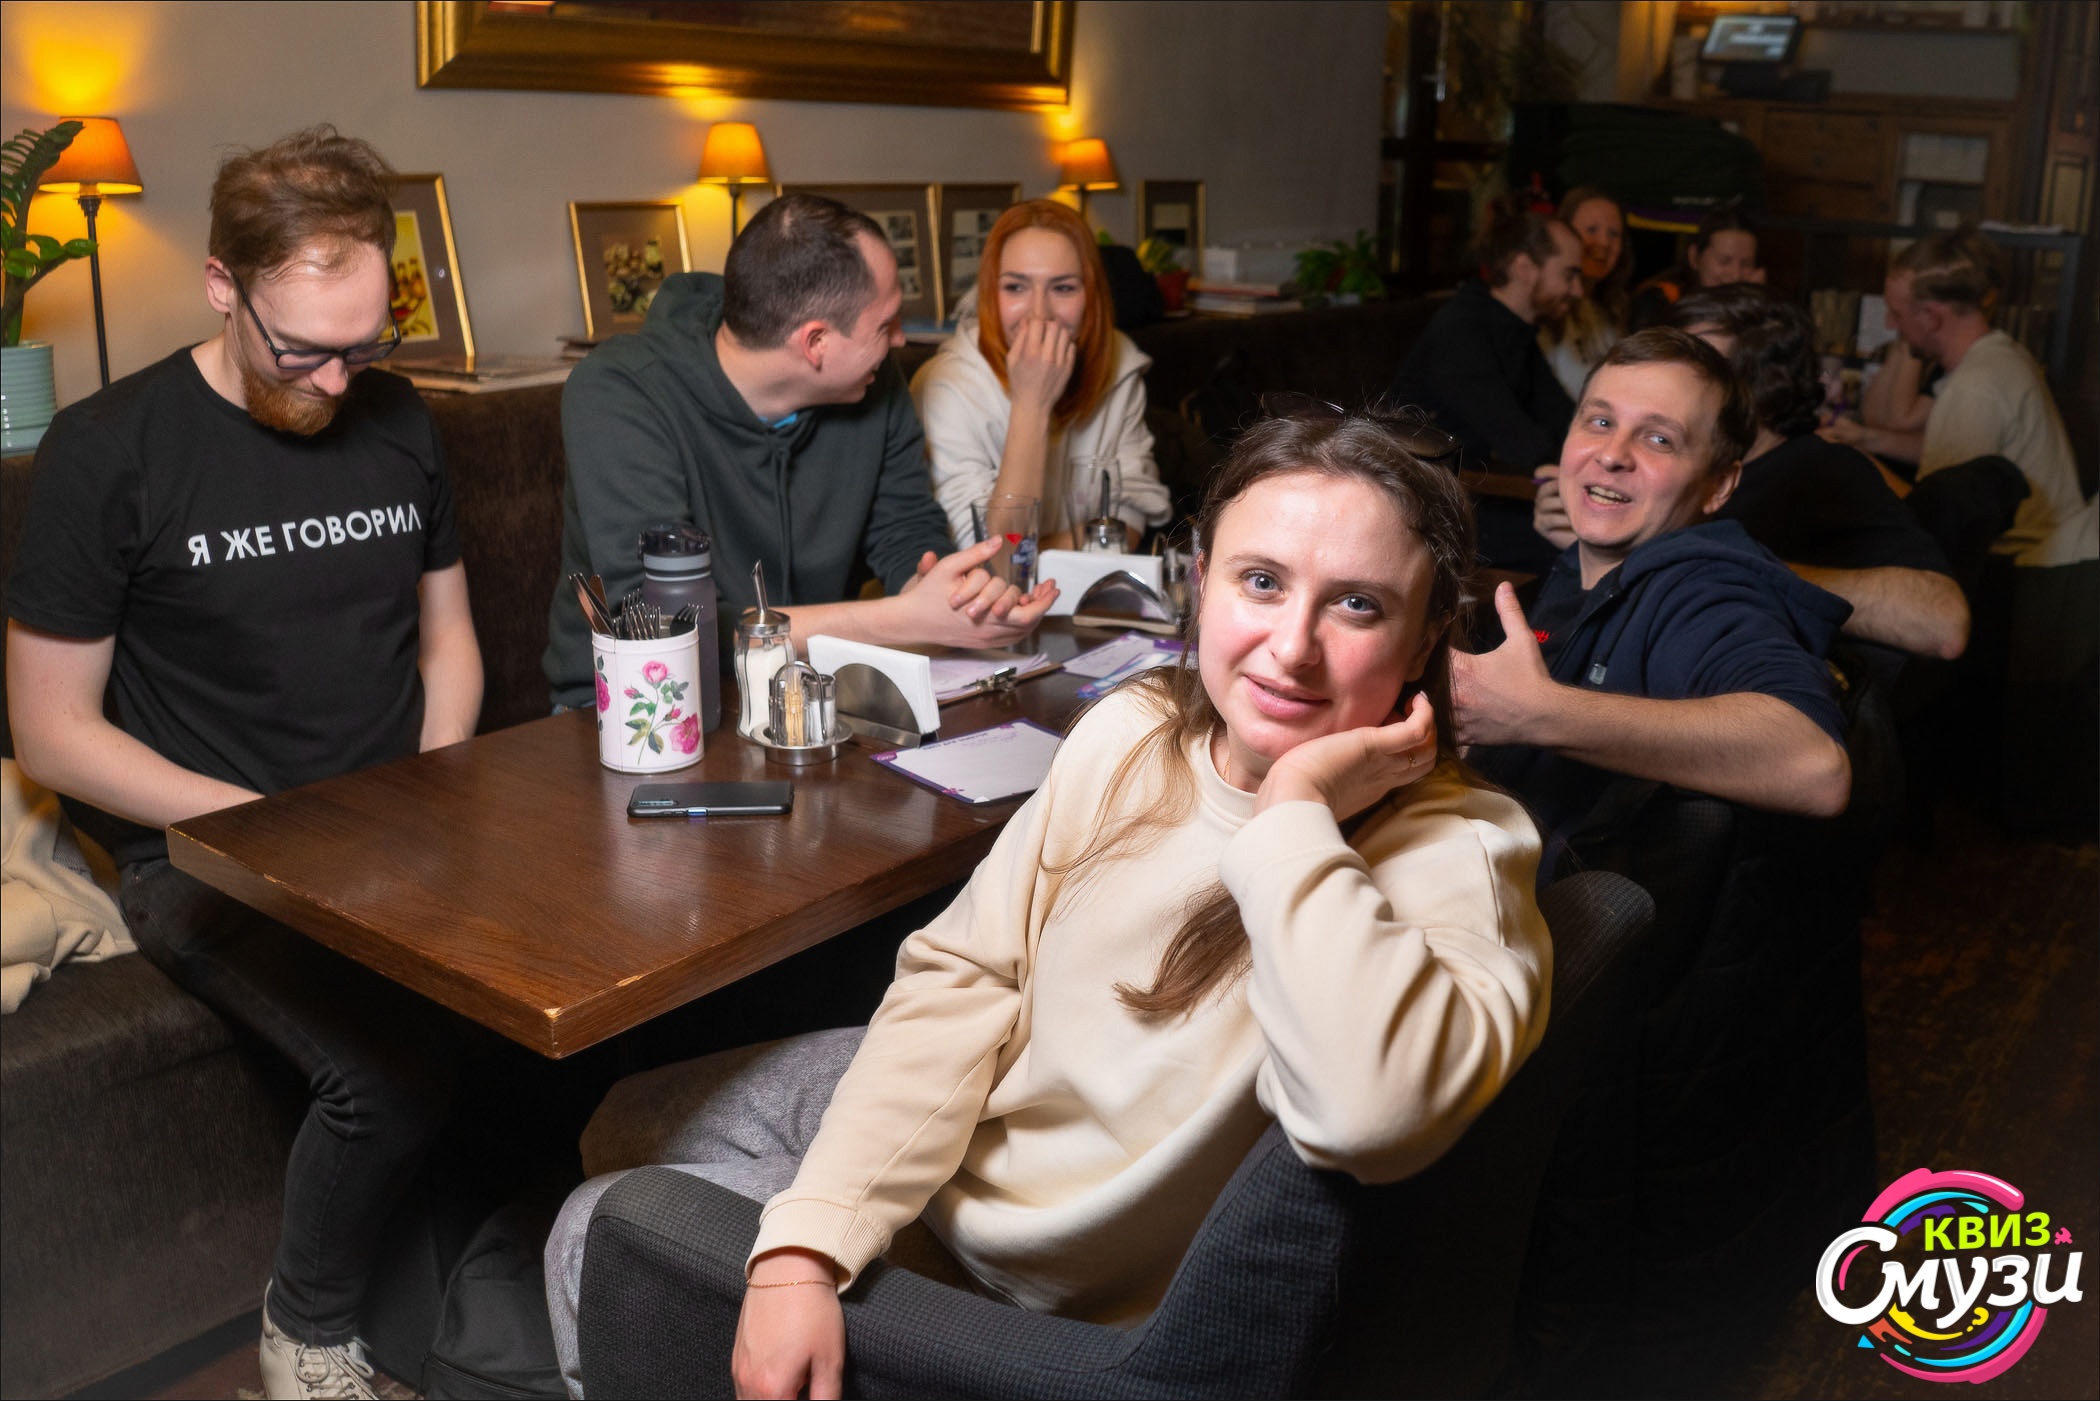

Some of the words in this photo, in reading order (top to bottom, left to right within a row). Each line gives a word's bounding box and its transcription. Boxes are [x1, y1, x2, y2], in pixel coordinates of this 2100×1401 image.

[188, 534, 211, 566] Я
[220, 525, 276, 561] ЖЕ
[281, 503, 422, 552] ГОВОРИЛ
